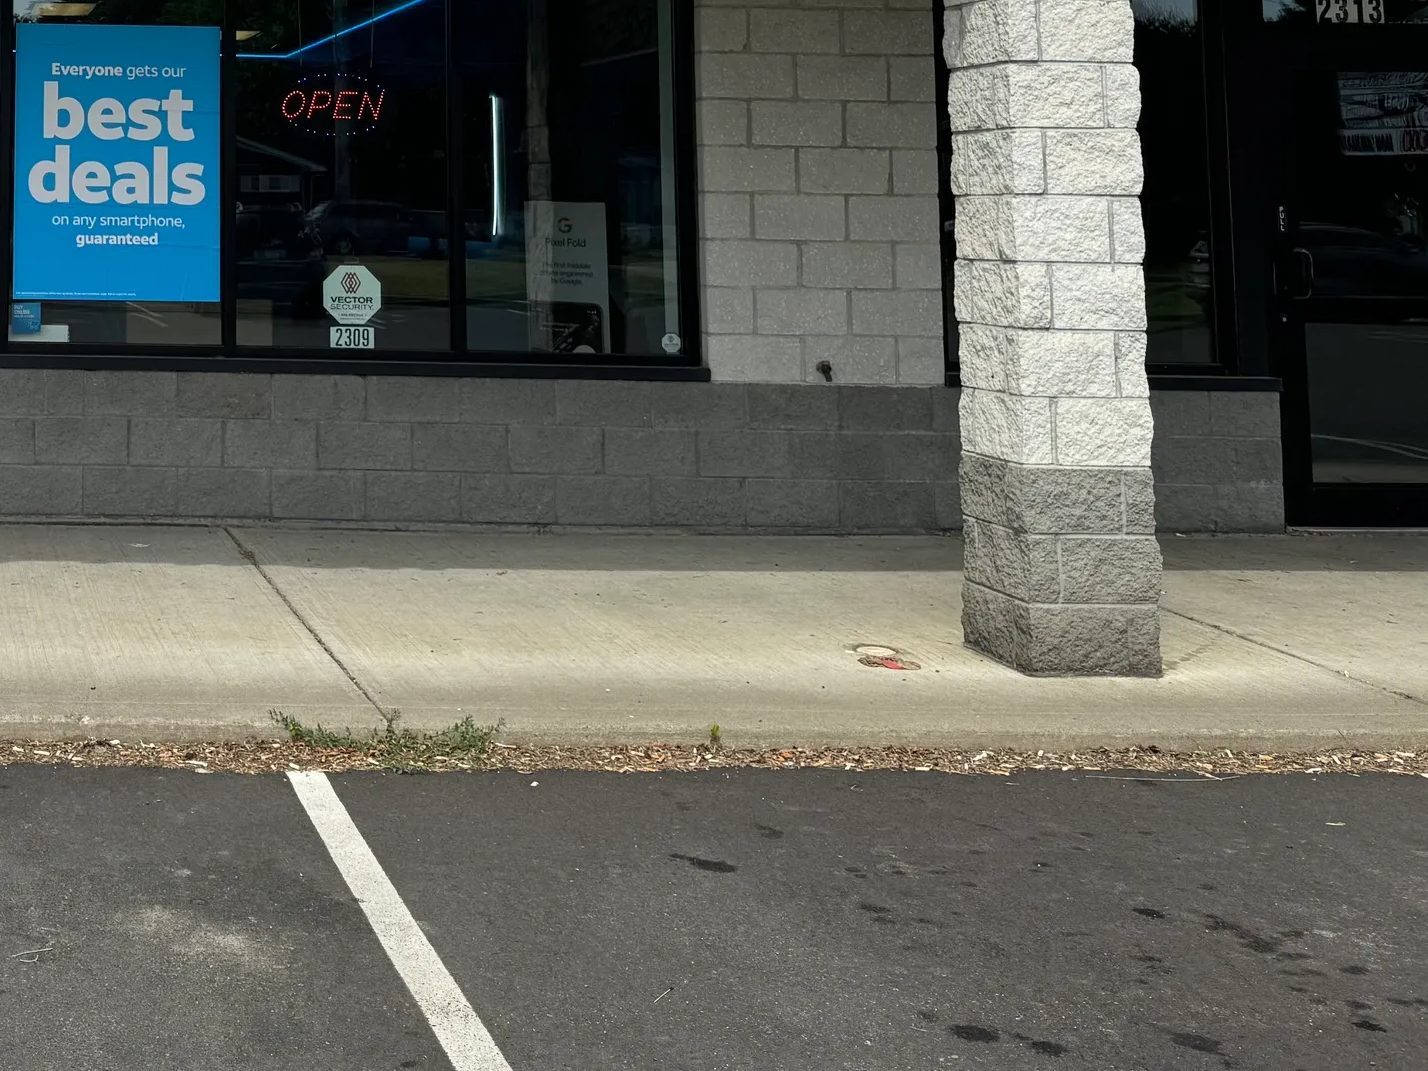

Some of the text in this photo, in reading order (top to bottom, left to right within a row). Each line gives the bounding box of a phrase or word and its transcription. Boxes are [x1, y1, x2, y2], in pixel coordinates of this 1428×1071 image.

[51, 62, 186, 80] Everyone gets our
[43, 81, 195, 141] best
[281, 89, 385, 120] OPEN
[28, 145, 206, 206] deals
[51, 214, 186, 229] on any smartphone,
[75, 232, 159, 247] guaranteed
[567, 238, 586, 247] Fold
[330, 296, 373, 304] VECTOR
[335, 328, 370, 347] 2309
